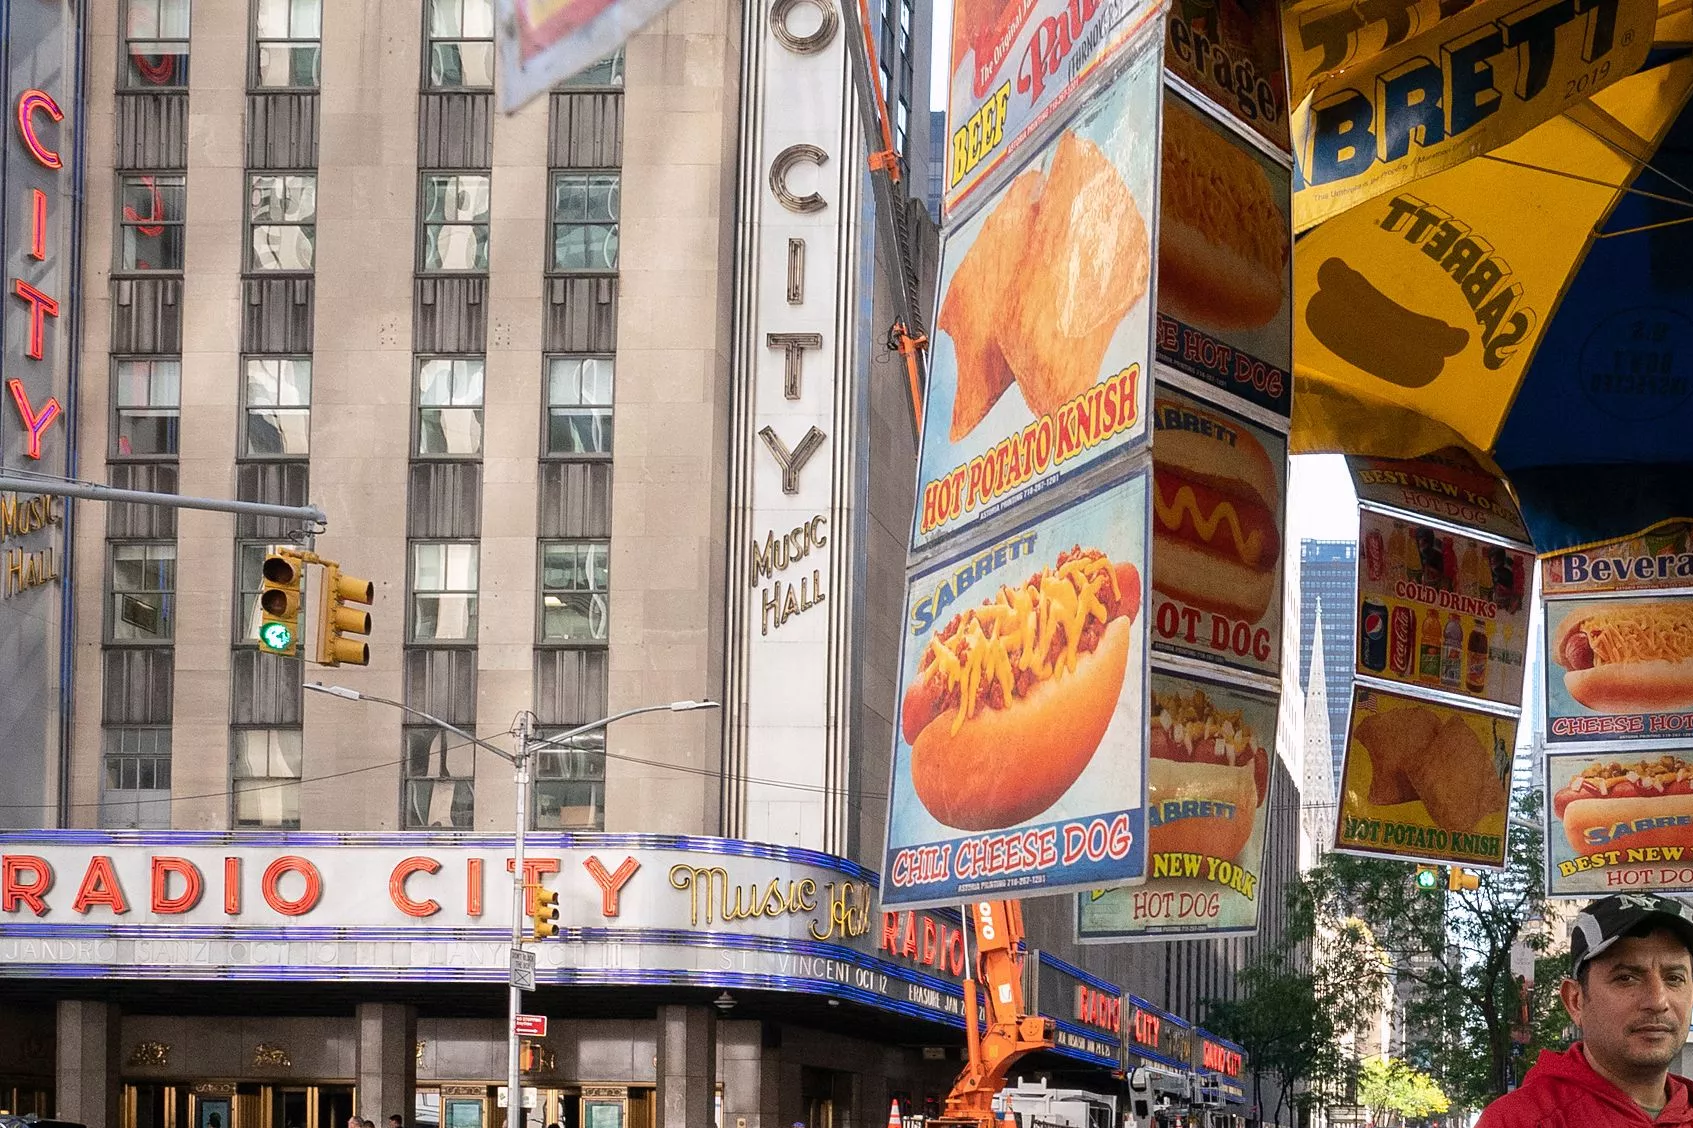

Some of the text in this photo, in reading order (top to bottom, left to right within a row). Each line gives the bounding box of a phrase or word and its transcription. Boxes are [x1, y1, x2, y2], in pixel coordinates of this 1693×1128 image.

[994, 16, 1021, 61] Original
[1565, 60, 1612, 99] 2019
[952, 79, 1012, 188] BEEF
[5, 89, 65, 461] CITY
[758, 144, 834, 496] CITY
[1184, 329, 1283, 398] HOT DOG
[920, 362, 1141, 534] HOT POTATO KNISH
[1359, 469, 1411, 486] BEST
[1412, 473, 1460, 498] NEW
[1401, 489, 1488, 525] HOT DOG
[4, 546, 58, 599] HALL
[751, 514, 829, 589] MUSIC
[760, 572, 827, 637] HALL
[910, 530, 1038, 637] SABRETT
[1395, 581, 1498, 619] COLD DRINKS
[1210, 614, 1271, 663] DOG
[1551, 715, 1644, 736] CHEESE
[891, 813, 1133, 888] CHILI CHEESE DOG
[1343, 815, 1503, 857] HOT POTATO KNISH
[1153, 851, 1258, 902] NEW YORK
[1557, 850, 1621, 877] BEST
[1626, 845, 1686, 862] NEW
[1606, 868, 1654, 886] HOT
[2, 854, 871, 941] RADIO CITY Music Hall
[1133, 893, 1178, 921] HOT
[1177, 891, 1221, 919] DOG
[136, 942, 210, 961] SANZ
[881, 911, 965, 978] RADIO
[777, 953, 851, 983] VINCENT
[855, 967, 875, 990] OCT
[879, 975, 888, 994] 12
[907, 983, 941, 1009] ERASURE
[945, 996, 958, 1013] JAN
[1079, 985, 1121, 1034] RADIO
[1133, 1008, 1161, 1048] CITY
